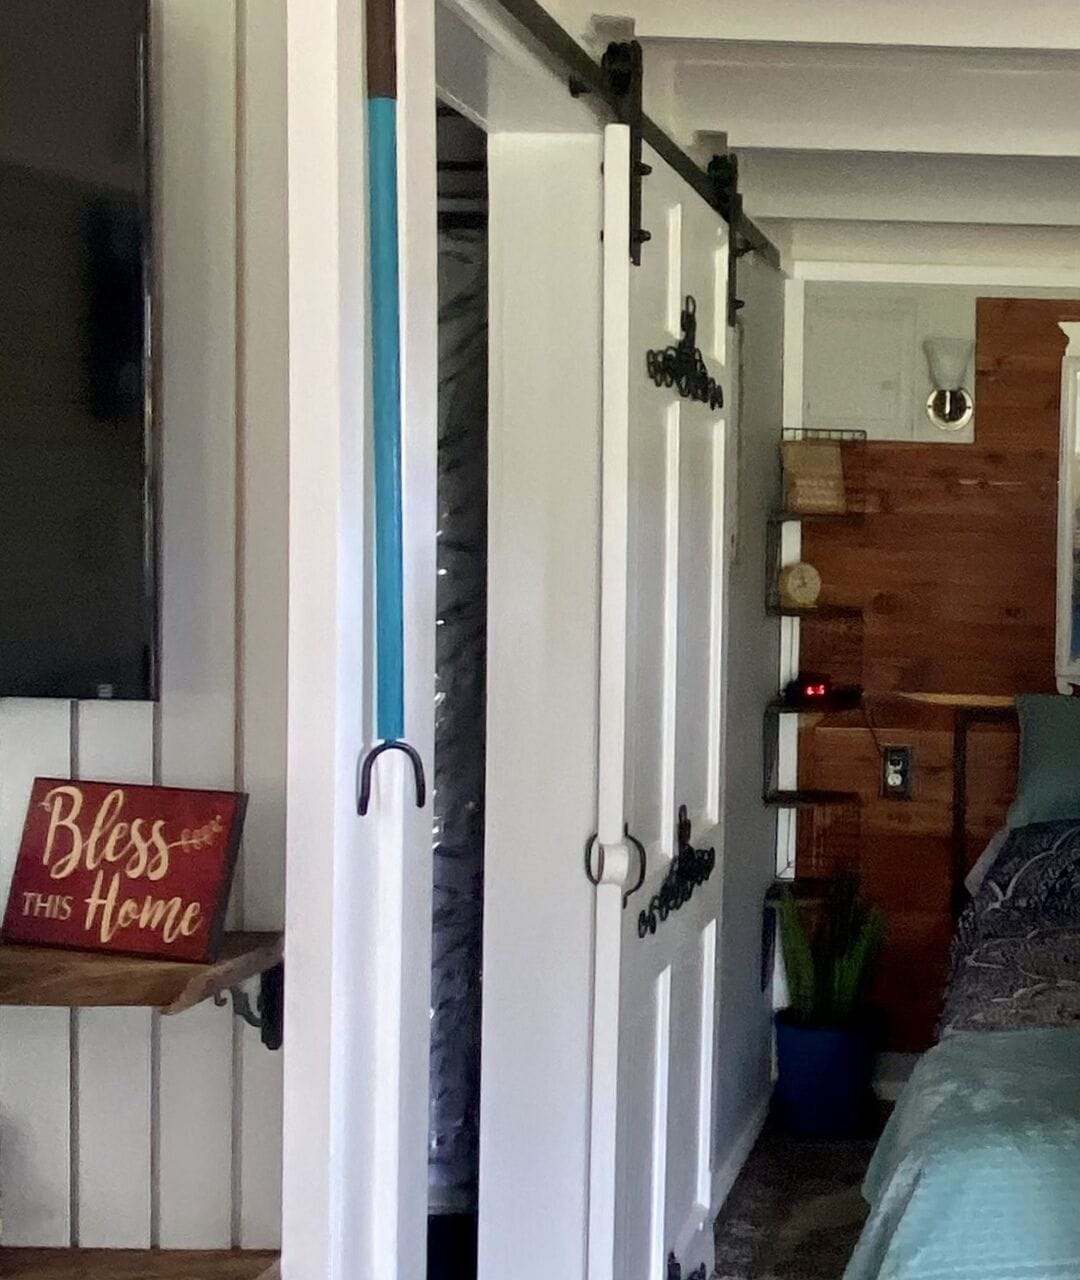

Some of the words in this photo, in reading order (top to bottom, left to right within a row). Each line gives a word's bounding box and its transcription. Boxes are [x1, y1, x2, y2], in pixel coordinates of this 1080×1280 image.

[42, 785, 169, 881] Bless
[22, 891, 73, 921] THIS
[84, 870, 202, 944] Home
